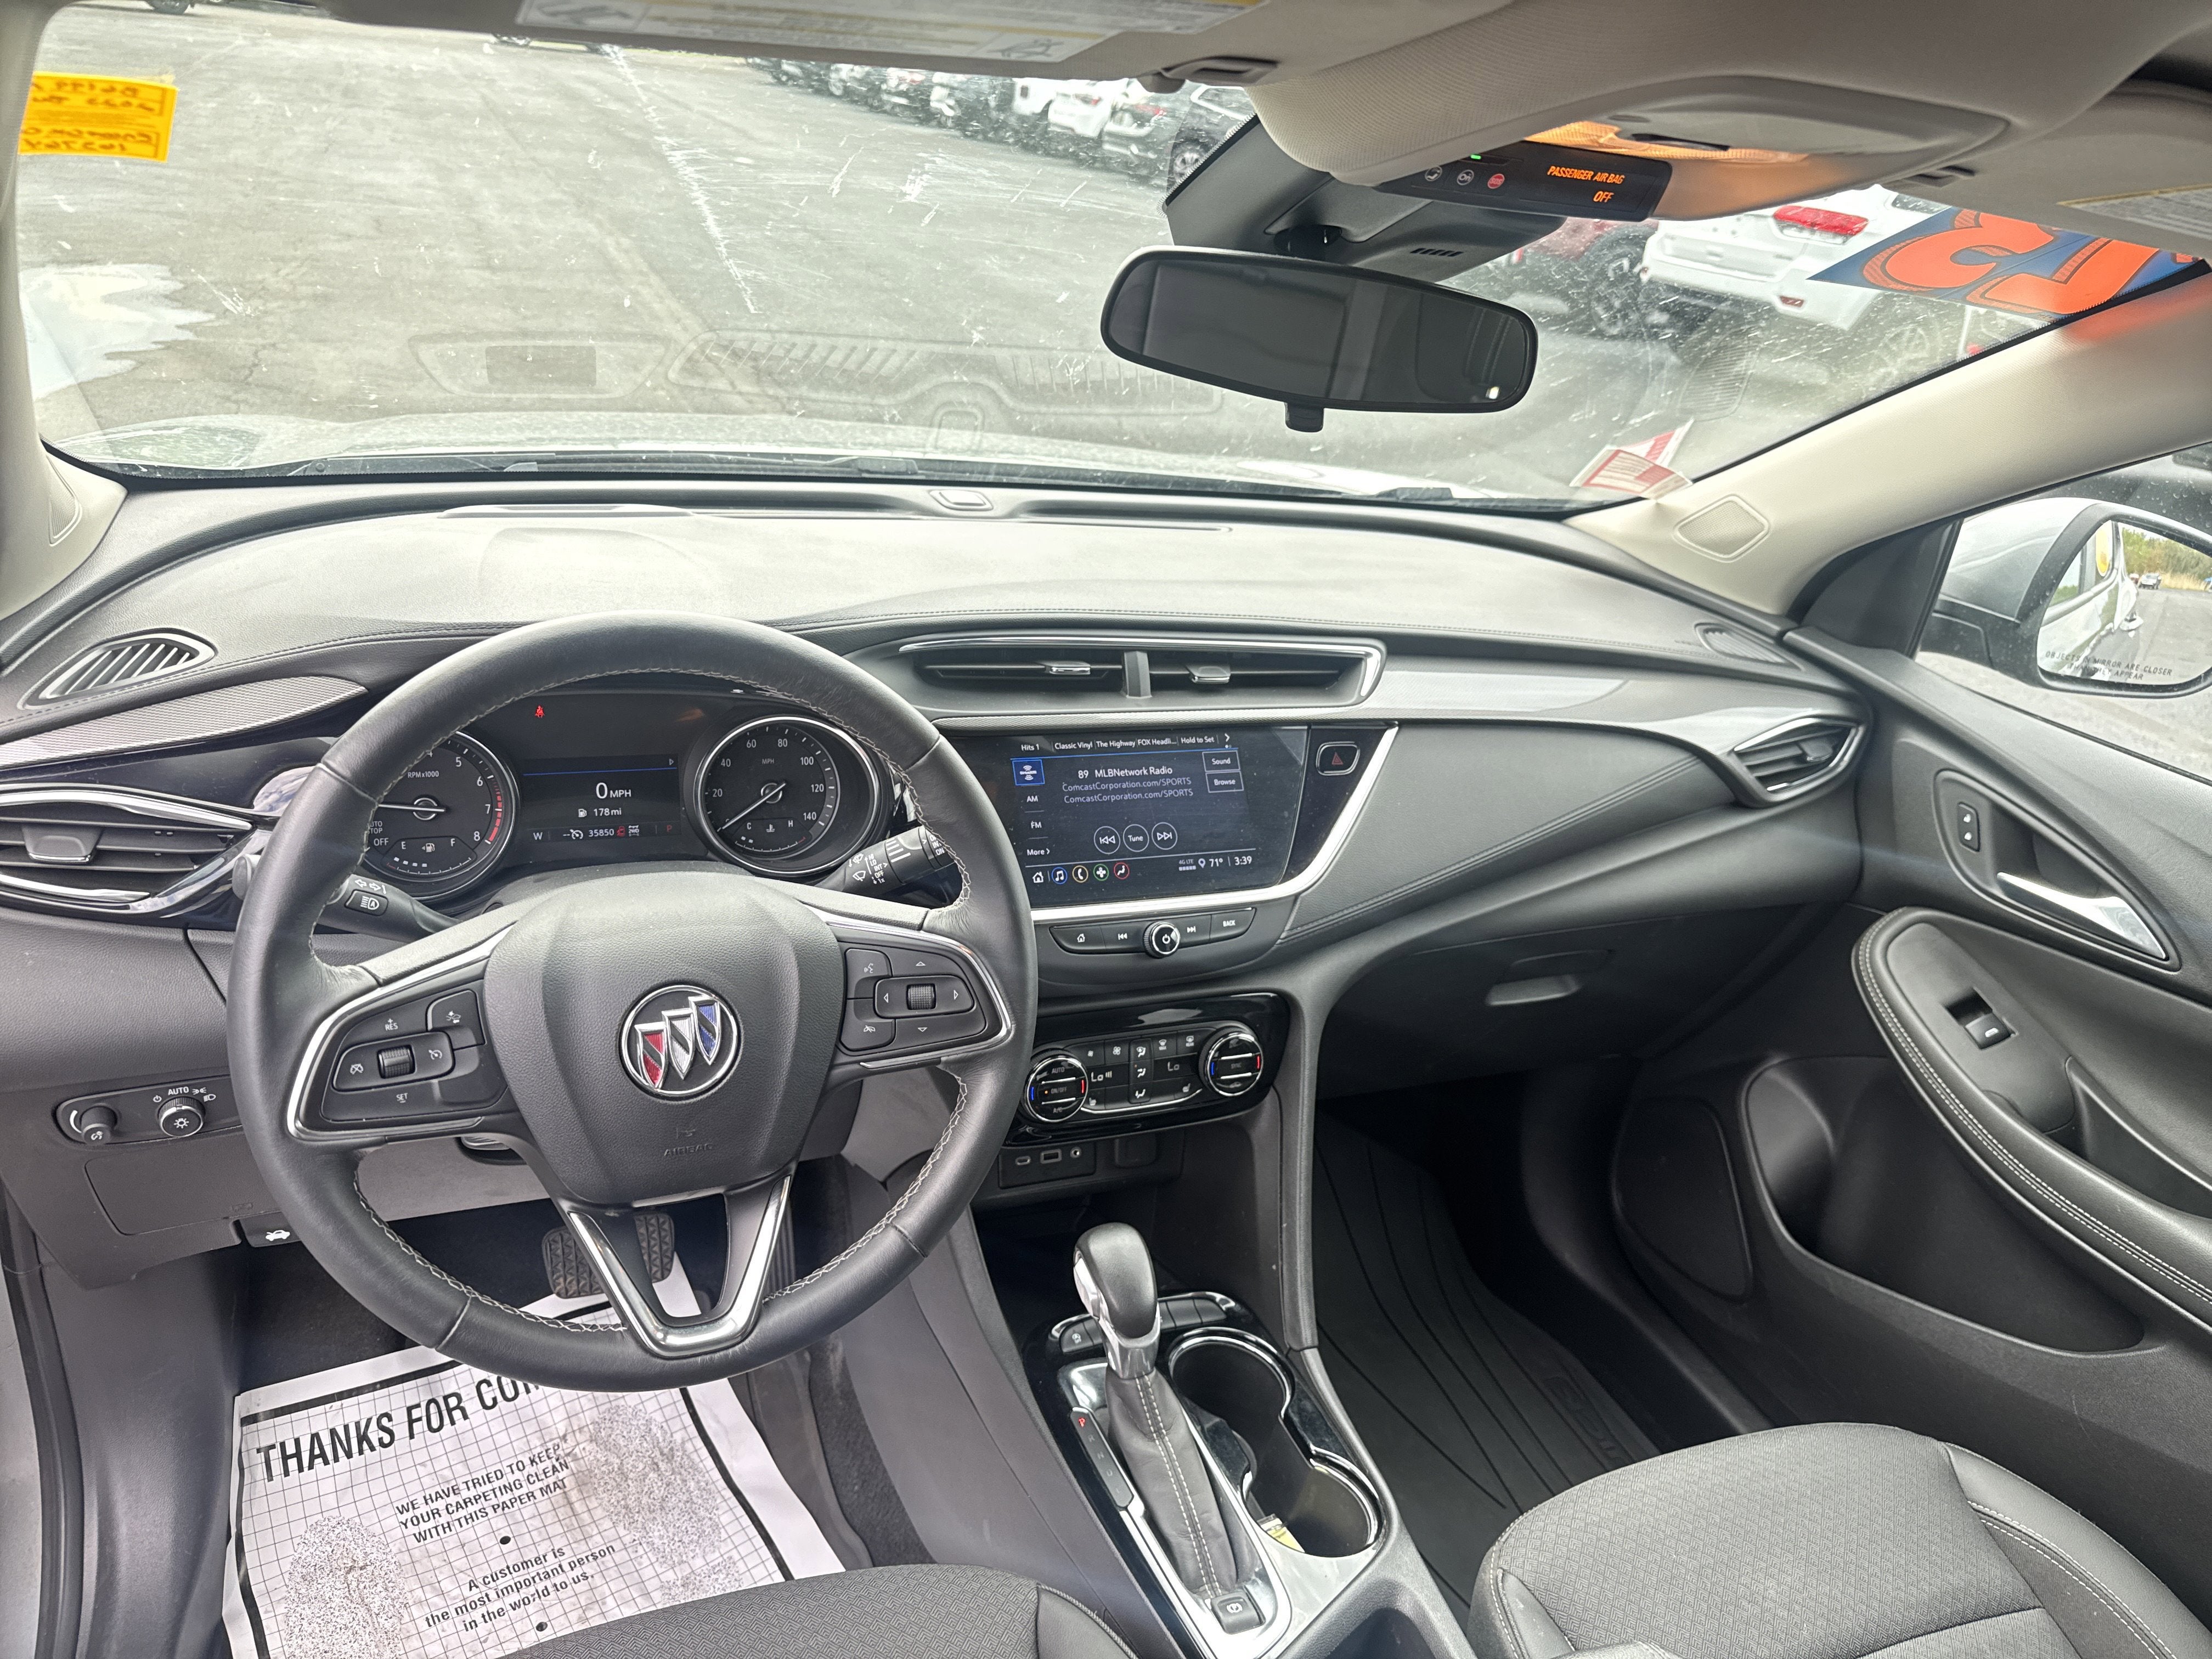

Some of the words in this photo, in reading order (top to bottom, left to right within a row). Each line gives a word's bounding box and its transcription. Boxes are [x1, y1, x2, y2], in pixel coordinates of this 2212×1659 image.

[1547, 166, 1594, 180] PASSENGER
[1593, 172, 1609, 183] AIR
[1607, 173, 1625, 184] BAG
[1593, 190, 1614, 202] OFF
[2092, 658, 2123, 668] MIRROR
[2125, 662, 2140, 672] ARE
[2143, 665, 2172, 676] CLOSER
[2114, 669, 2143, 681] APPEAR
[746, 739, 757, 748] 60
[777, 738, 788, 748] 80
[1054, 742, 1077, 750] Classic
[1077, 741, 1093, 750] Vinyl
[1109, 740, 1136, 748] Highway
[455, 757, 462, 767] 5
[720, 758, 731, 768] 40
[800, 756, 815, 766] 100
[1077, 770, 1089, 779] 89
[1094, 767, 1148, 778] MLBNetwork
[1149, 765, 1173, 776] Radio
[476, 776, 483, 787] 6
[1062, 777, 1192, 792] ComcastCorporation.com/SPORTS
[595, 782, 608, 799] 0
[610, 789, 631, 798] MPH
[712, 788, 723, 797] 20
[810, 783, 825, 793] 120
[1064, 788, 1194, 804] ComcastCorporation.com/SPORTS
[484, 804, 491, 814] 7
[593, 808, 610, 817] 178
[803, 811, 817, 821] 140
[747, 822, 752, 831] C
[788, 819, 793, 827] H
[588, 828, 614, 838] 35850
[666, 825, 673, 833] P
[473, 831, 481, 842] 8
[533, 832, 543, 840] W
[374, 837, 389, 847] OFF
[401, 841, 407, 850] E
[450, 838, 456, 847] F
[935, 848, 945, 856] ON
[1209, 857, 1223, 867] 71°
[1234, 855, 1252, 866] 3:39
[874, 870, 884, 879] OFF
[385, 1022, 398, 1031] RES
[168, 1086, 189, 1096] AUTO
[396, 1092, 408, 1101] SET
[256, 1412, 396, 1483] THANKS
[406, 1392, 470, 1440] FOR
[396, 1498, 420, 1515] WE
[423, 1484, 460, 1506] HAVE
[462, 1469, 504, 1492] TRIED
[506, 1460, 526, 1475] TO
[528, 1443, 561, 1467] KEEP
[400, 1508, 442, 1530] YOUR
[445, 1479, 523, 1515] CARPETING
[526, 1459, 569, 1485] CLEAN
[413, 1521, 452, 1543] WITH
[455, 1507, 489, 1529] THIS
[492, 1491, 537, 1514] PAPER
[539, 1477, 568, 1497] MAT
[467, 1579, 479, 1592] A
[482, 1553, 548, 1587] customer
[551, 1547, 566, 1560] is
[425, 1610, 450, 1628] the
[454, 1592, 492, 1616] most
[494, 1563, 566, 1599] important
[568, 1544, 616, 1571] person
[462, 1619, 478, 1632] in
[481, 1606, 506, 1624] the
[509, 1585, 549, 1611] world
[553, 1580, 568, 1592] to
[571, 1570, 595, 1585] us.
